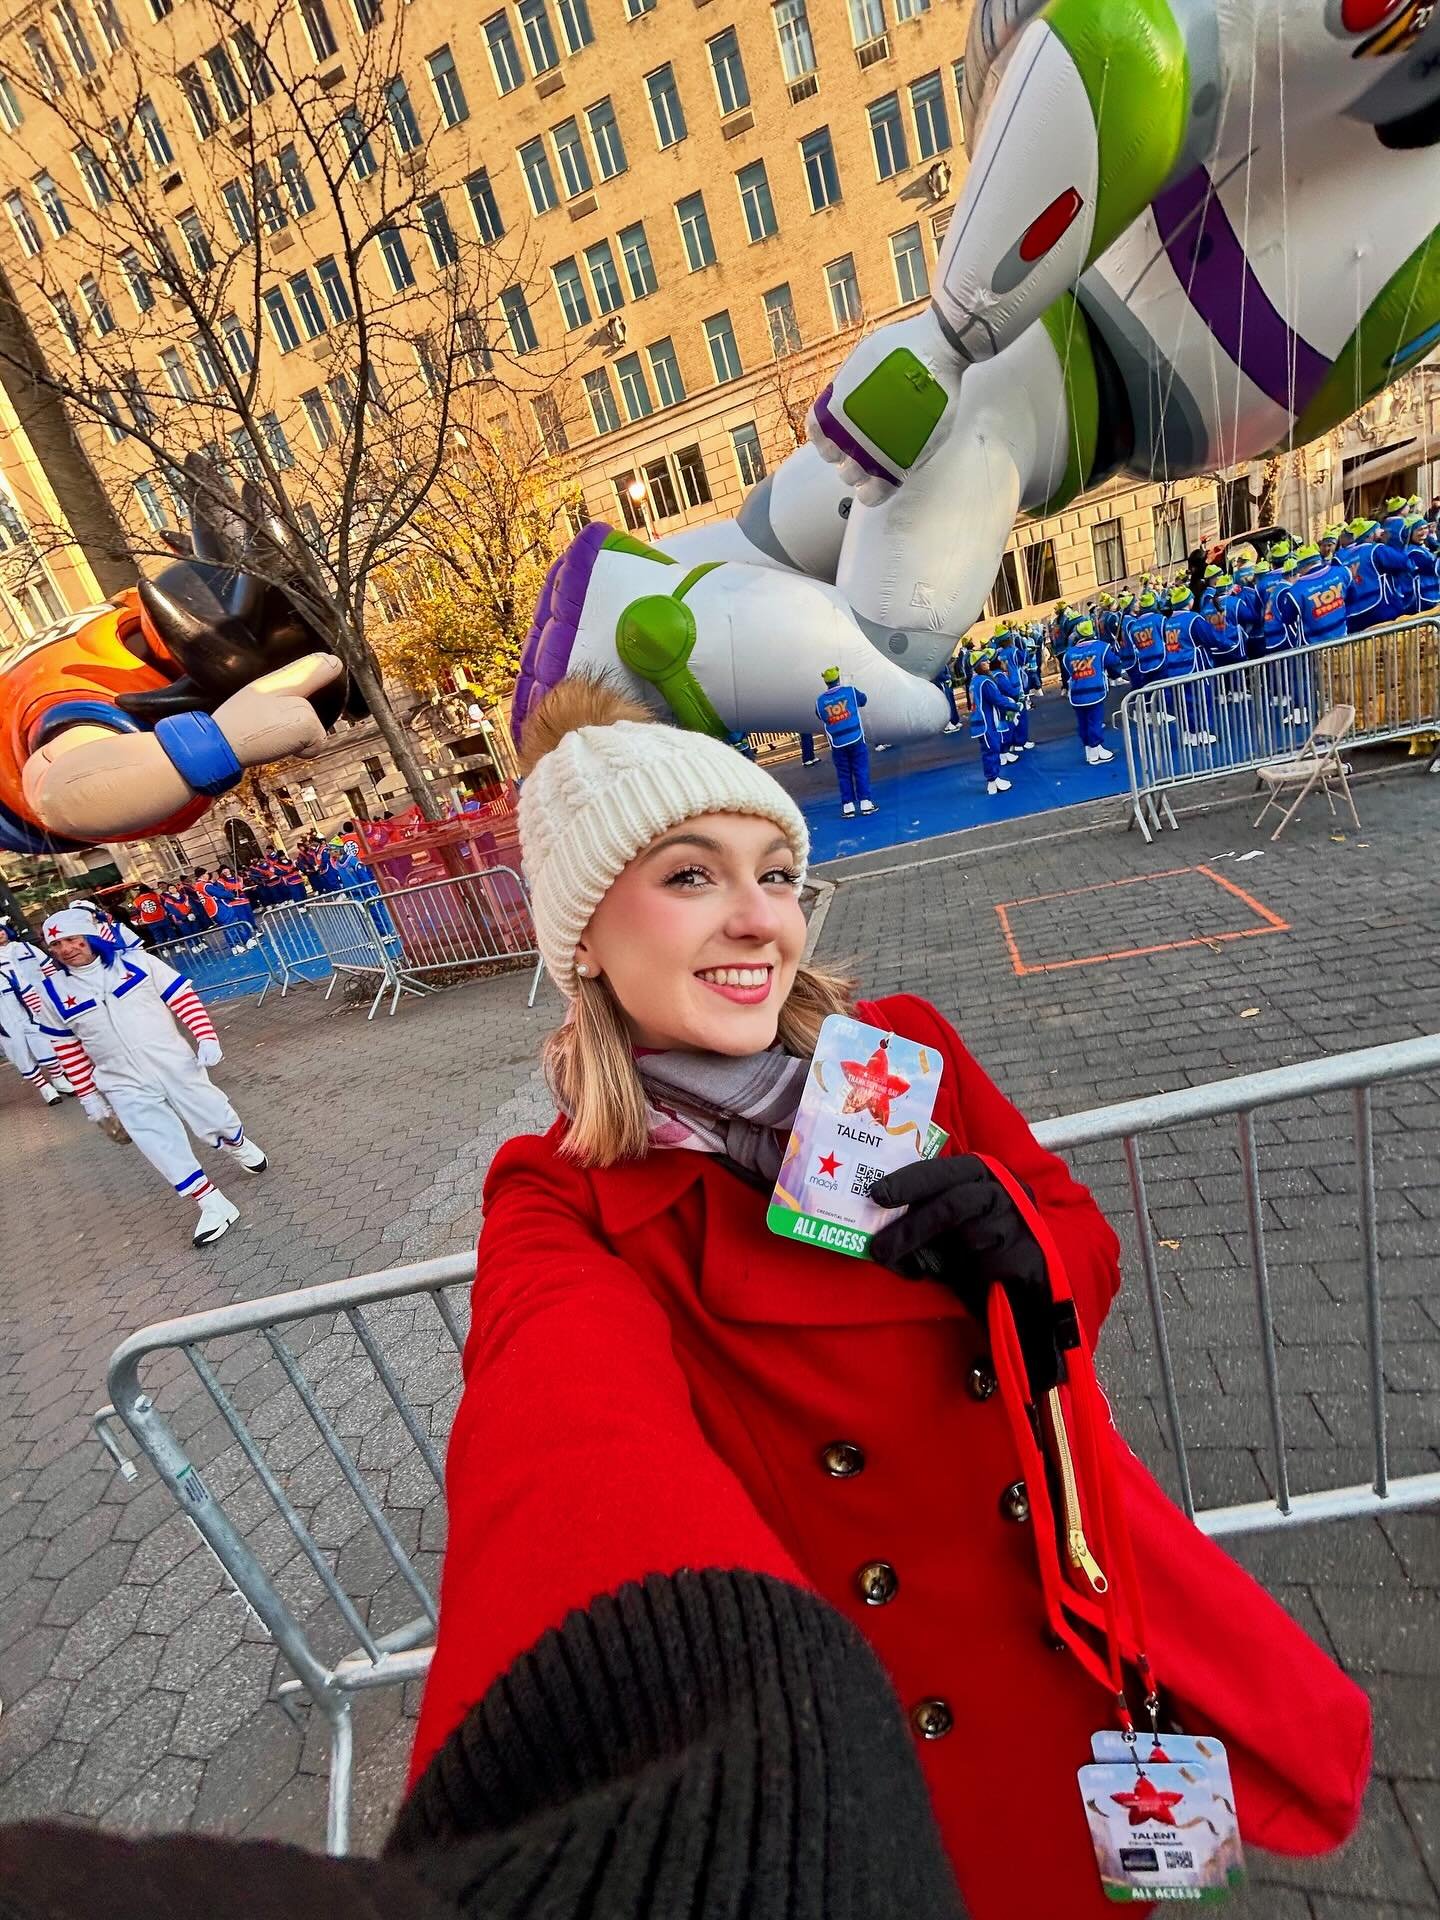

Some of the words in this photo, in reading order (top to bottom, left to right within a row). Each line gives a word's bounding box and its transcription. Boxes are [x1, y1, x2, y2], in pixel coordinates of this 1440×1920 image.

[1307, 582, 1343, 608] TOY
[1313, 598, 1344, 618] STORY
[1070, 654, 1096, 671] TOY
[824, 699, 848, 717] TOY
[836, 1124, 883, 1148] TALENT
[809, 1175, 839, 1191] macy's
[792, 1217, 817, 1239] ALL
[818, 1224, 867, 1253] ACCESS
[1131, 1832, 1177, 1840] TALENT
[1131, 1887, 1153, 1899] ALL
[1155, 1887, 1201, 1899] ACCESS
